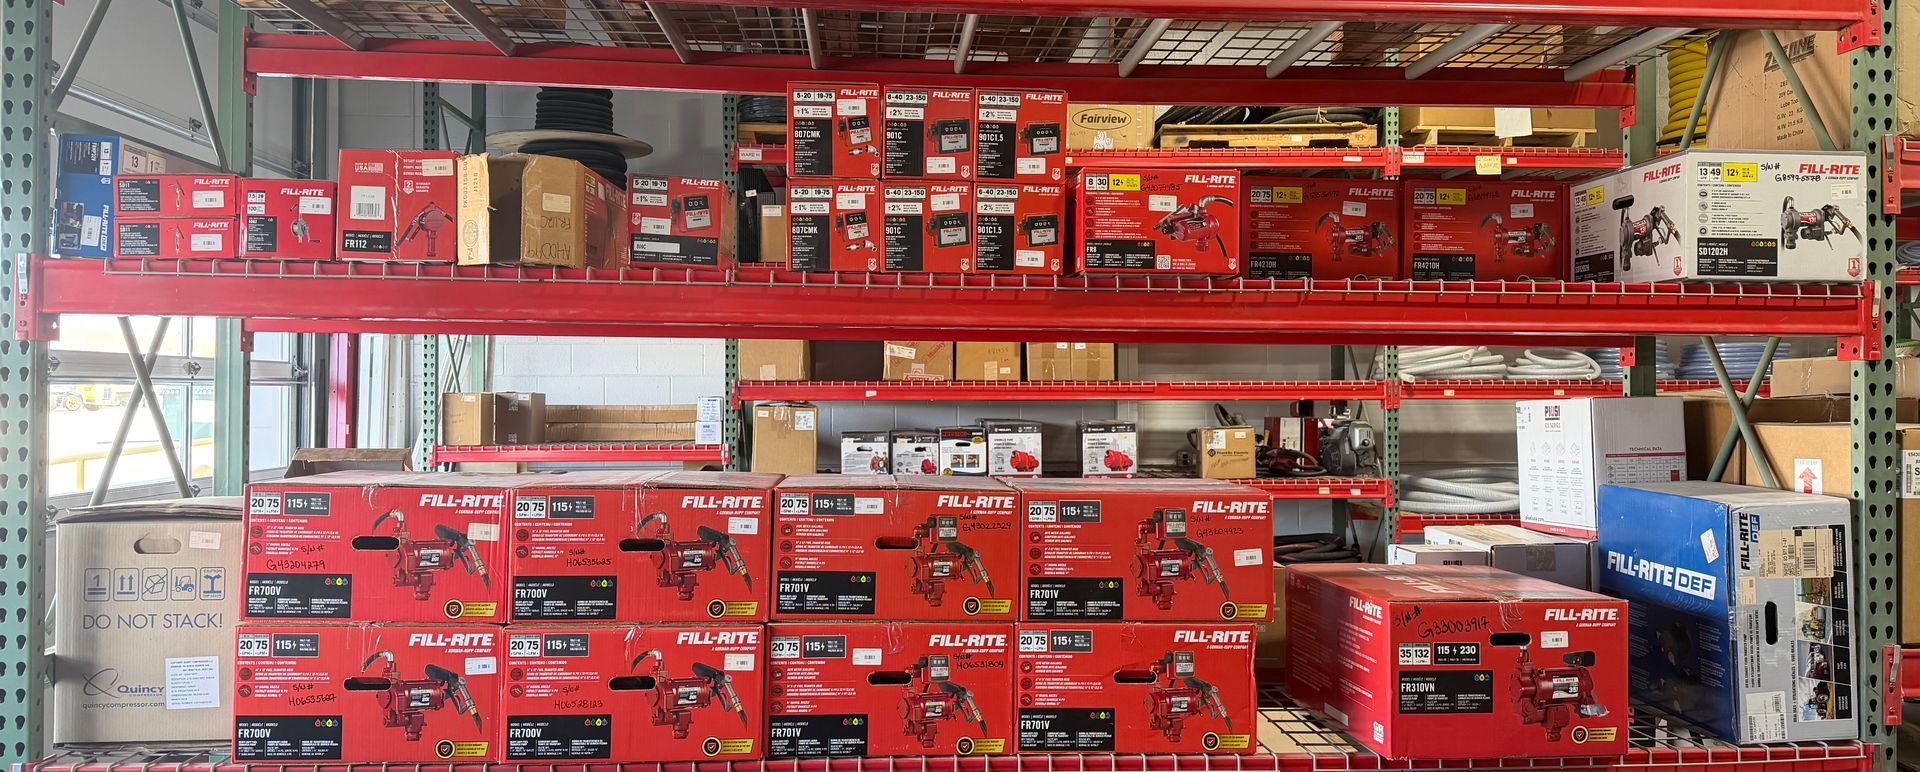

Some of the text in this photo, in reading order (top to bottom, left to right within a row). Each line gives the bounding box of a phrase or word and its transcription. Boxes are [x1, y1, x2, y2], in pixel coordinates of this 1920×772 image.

[840, 89, 879, 97] FILL-RITE
[905, 93, 927, 102] 23-150
[932, 91, 970, 99] FILL-RITE
[1025, 93, 1064, 102] FILL-RITE
[998, 96, 1019, 104] 23-150
[1080, 114, 1127, 123] Fairview
[794, 130, 821, 139] 807CMK
[886, 131, 903, 140] 901C
[978, 133, 1004, 142] 901C1.5
[1792, 129, 1804, 137] China
[131, 156, 139, 169] 13
[1643, 163, 1681, 182] FILL-RITE
[1699, 168, 1721, 176] 13 49
[1727, 168, 1735, 177] 12
[1799, 163, 1861, 175] FILL-RITE
[681, 178, 720, 187] FILL-RITE
[1097, 178, 1107, 186] 30
[1184, 175, 1236, 184] FILL-RITE
[280, 188, 325, 196] FILL-RITE
[793, 188, 809, 196] 5-20
[837, 185, 876, 193] FILL-RITE
[903, 189, 925, 197] 23-150
[931, 185, 969, 193] FILL-RITE
[996, 188, 1018, 197] 23-150
[1023, 185, 1061, 193] FILL-RITE
[1251, 190, 1261, 198] 20
[1349, 187, 1394, 198] FILL-RITE
[1511, 189, 1556, 199] FILL-RITE
[1276, 191, 1284, 199] 12
[1415, 192, 1424, 200] 20
[101, 205, 110, 235] FILL-RITE
[791, 226, 818, 234] 807CMK
[885, 226, 902, 234] 901C
[977, 226, 1002, 234] 901C1.5
[345, 239, 367, 249] FR112
[1699, 247, 1728, 256] SD1202H
[1250, 260, 1277, 269] FR4210H
[1414, 261, 1440, 269] FR4210H
[1545, 405, 1560, 417] PIUSI
[251, 498, 279, 508] 20 75
[286, 499, 303, 508] 115
[419, 494, 504, 507] FILL-RITE
[682, 496, 762, 508] FILL-RITE
[781, 499, 808, 508] 20 75
[814, 499, 830, 509] 115
[937, 495, 1014, 509] FILL-RITE
[516, 502, 545, 512] 20 75
[552, 502, 568, 512] 115
[1030, 506, 1056, 516] 20 75
[1061, 506, 1077, 516] 115
[1192, 501, 1269, 513] FILL-RITE
[1738, 512, 1750, 570] FILL-RITE
[1607, 550, 1712, 593] FILL-RITE DEF
[248, 587, 281, 596] FR700V
[780, 583, 809, 593] FR701V
[515, 589, 548, 598] FR700V
[1030, 589, 1059, 599] FR701V
[1349, 596, 1383, 619] FILL-RITE
[1544, 608, 1618, 621] FILL-RITE
[82, 613, 223, 630] DO NOT STACK!
[408, 634, 494, 647] FILL-RITE
[677, 631, 759, 645] FILL-RITE
[929, 634, 1006, 647] FILL-RITE
[1020, 636, 1046, 645] 20 75
[1053, 636, 1068, 645] 115
[1174, 630, 1250, 643] FILL-RITE
[239, 640, 268, 650] 20 75
[275, 640, 292, 650] 115
[511, 640, 539, 650] 20 75
[546, 640, 563, 650] 115
[772, 642, 798, 652] 20 75
[805, 641, 821, 652] 115
[1437, 645, 1476, 655] 115 230
[1400, 649, 1429, 658] 35 132
[117, 684, 164, 697] Quincy
[1401, 682, 1435, 693] FR310VN
[82, 701, 165, 709] quincycompressor.com
[1021, 720, 1050, 730] FR701V
[238, 728, 271, 738] FR700V
[510, 728, 542, 738] FR700V
[771, 728, 801, 738] FR701V
